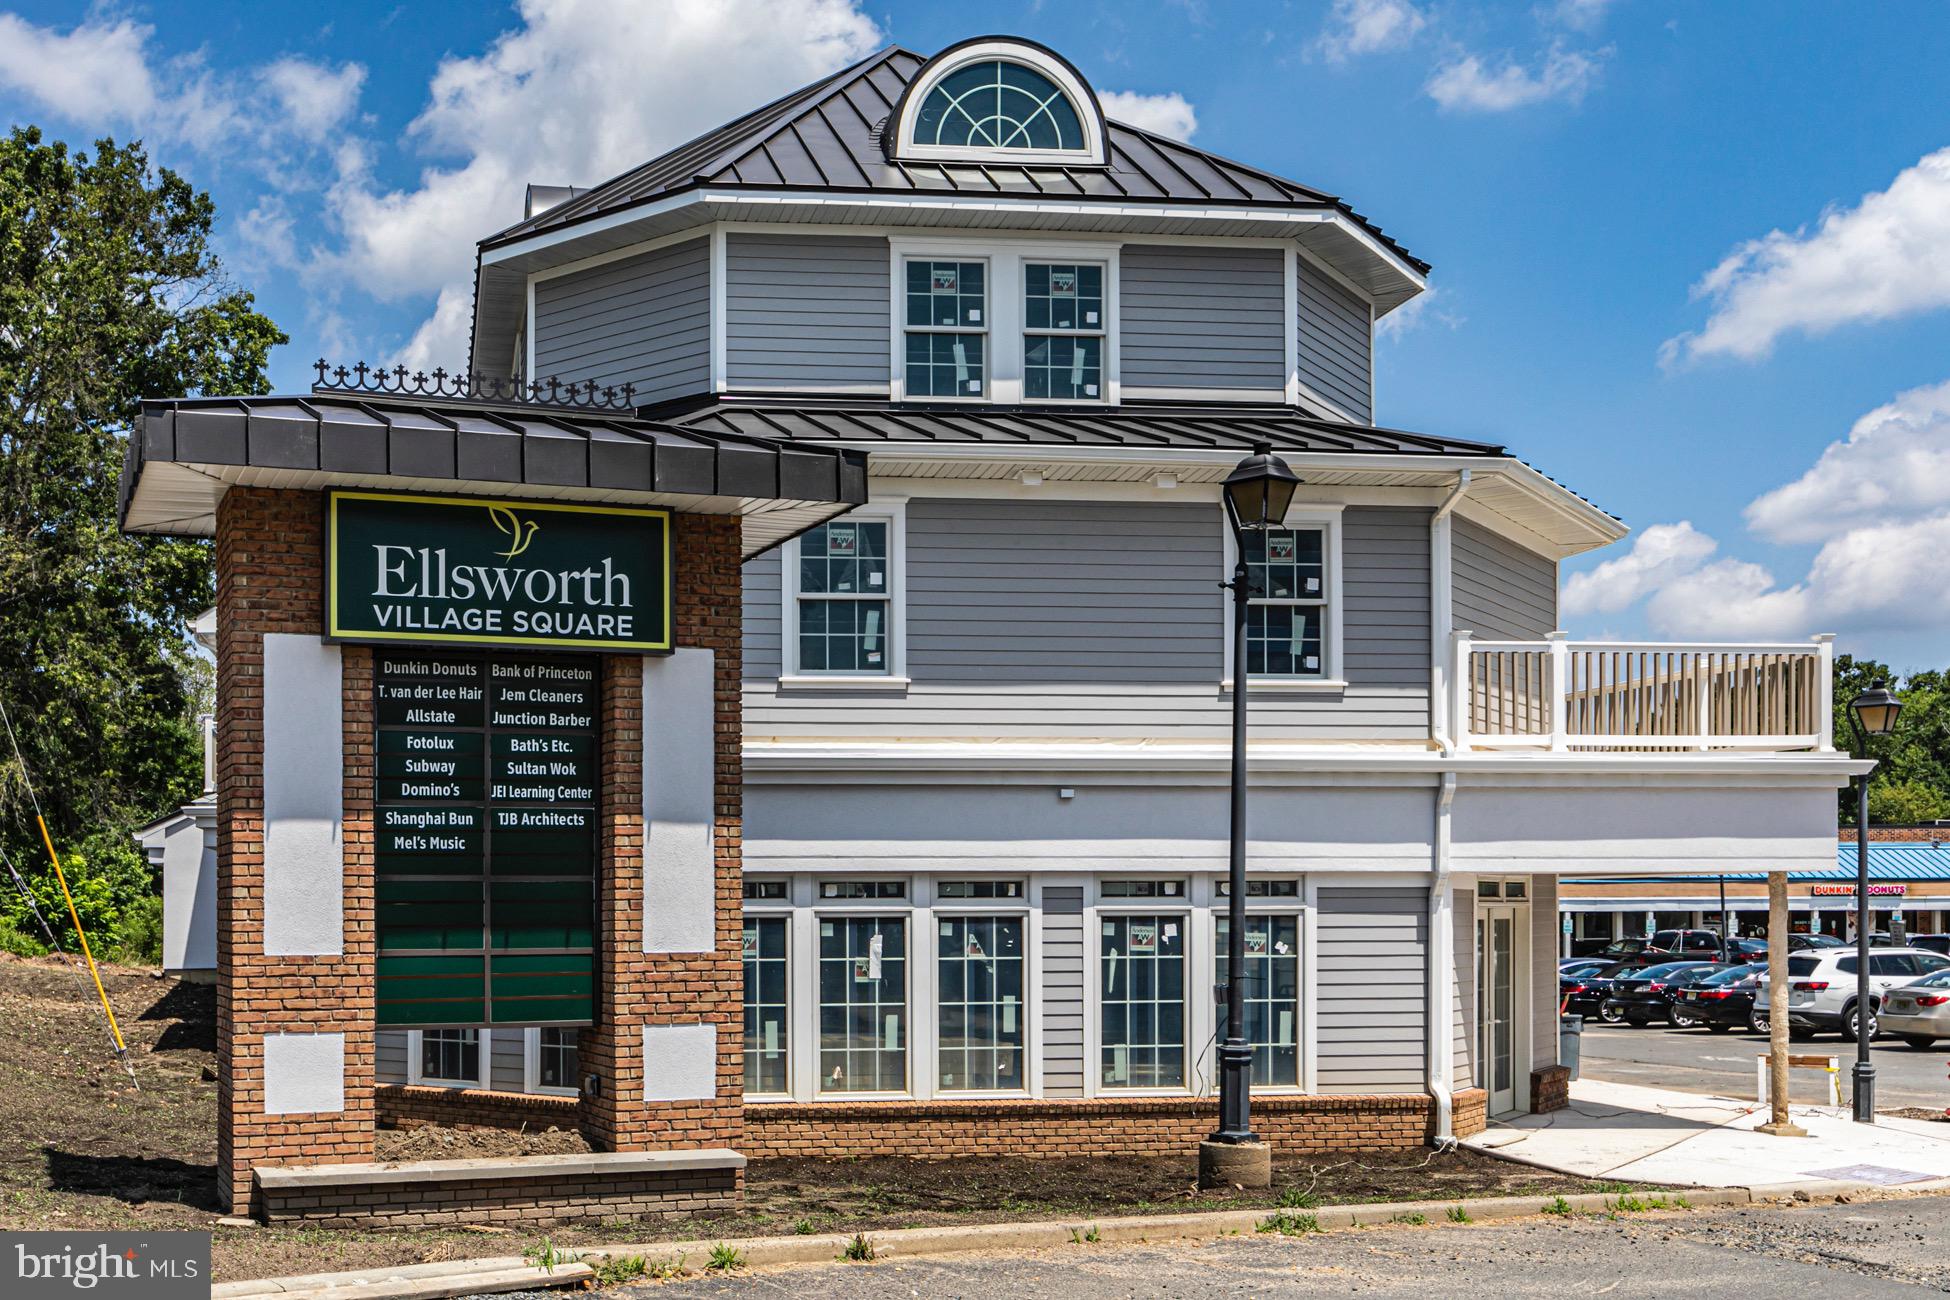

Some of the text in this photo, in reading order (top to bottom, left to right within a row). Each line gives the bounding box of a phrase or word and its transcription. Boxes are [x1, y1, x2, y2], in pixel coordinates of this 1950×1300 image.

[371, 544, 633, 607] Ellsworth
[373, 604, 633, 637] VILLAGE SQUARE
[384, 661, 477, 676] Dunkin Donuts
[492, 664, 592, 680] Bank of Princeton
[379, 685, 482, 700] T. van der Lee Hair
[500, 688, 583, 703] Jem Cleaners
[406, 709, 455, 722] Allstate
[493, 712, 591, 727] Junction Barber
[407, 736, 454, 749] Fotolux
[511, 739, 573, 752] Bath's Etc.
[405, 759, 455, 776] Subway
[507, 762, 576, 775] Sultan Wok
[402, 783, 459, 796] Domino's
[491, 785, 592, 802] JEI Learning Center
[385, 812, 473, 828] Shanghai Bun
[498, 812, 584, 826] TJB Architects
[394, 836, 465, 850] Mel's Music
[1868, 885, 1906, 895] DONUTS
